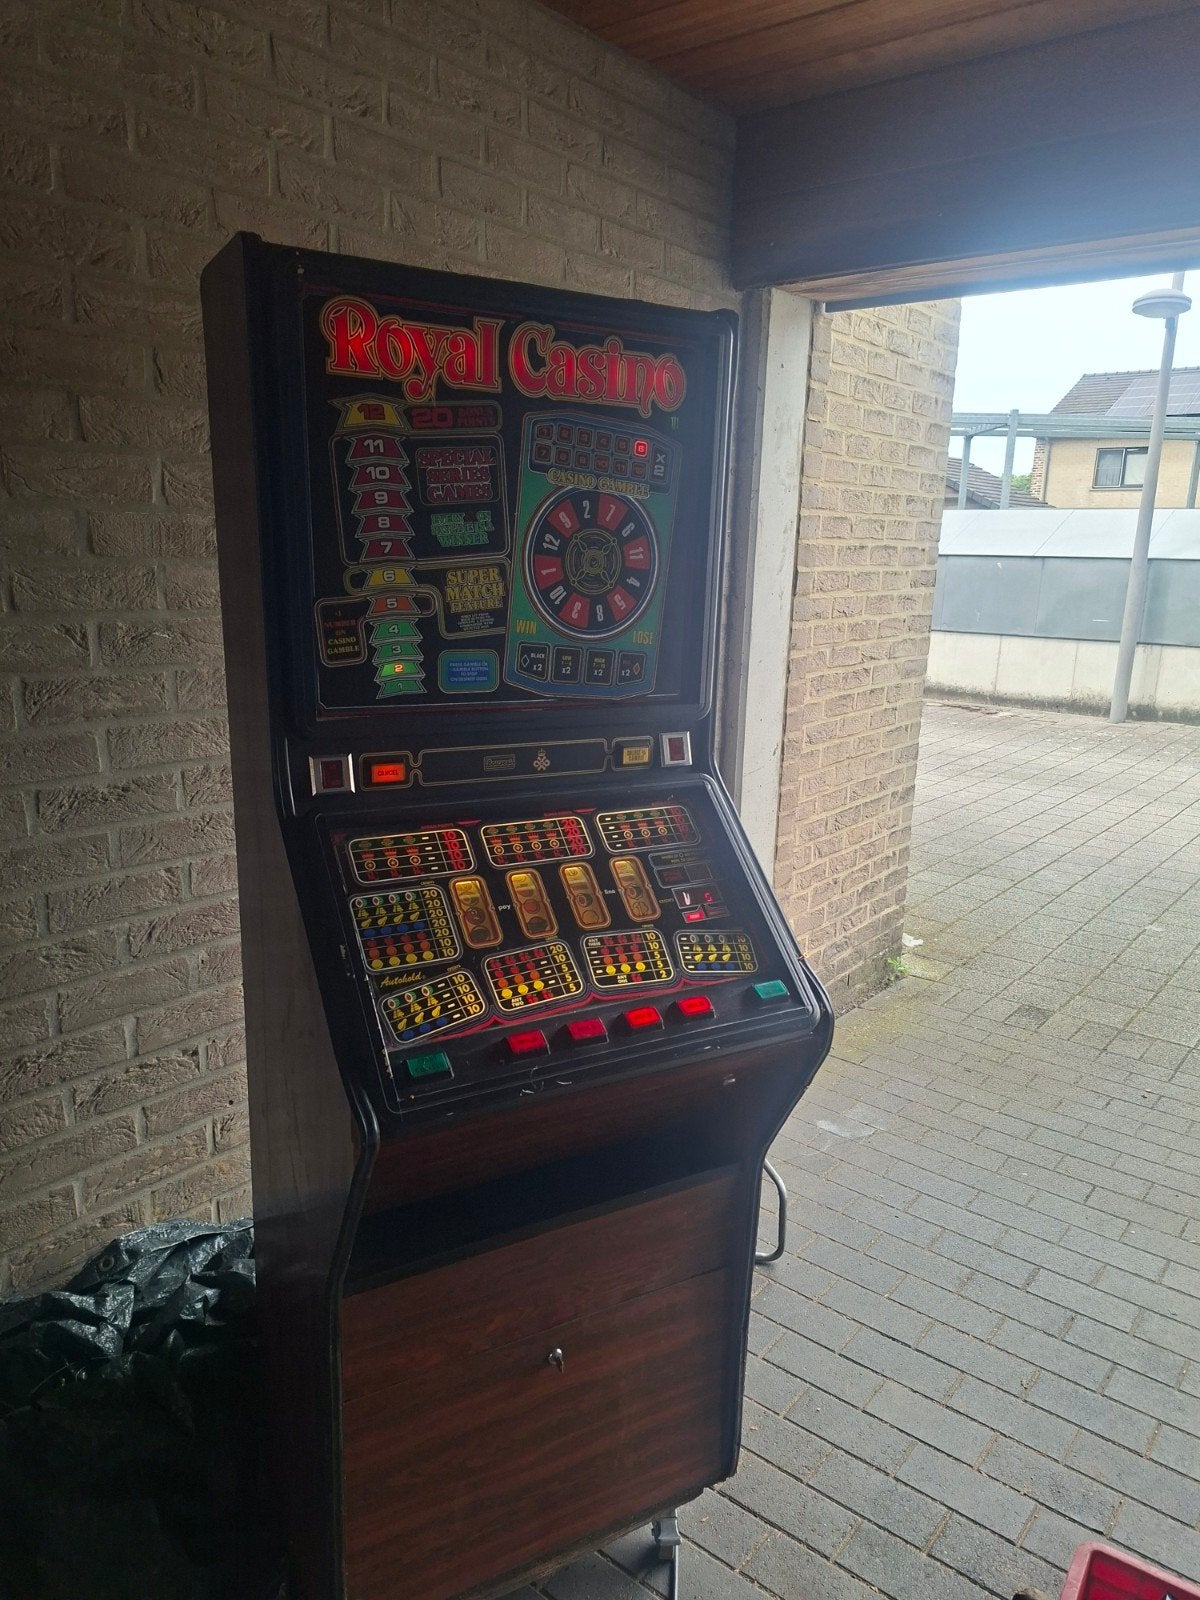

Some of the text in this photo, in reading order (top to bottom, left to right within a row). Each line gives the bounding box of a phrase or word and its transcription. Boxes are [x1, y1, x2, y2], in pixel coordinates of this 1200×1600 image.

[321, 295, 687, 418] Royal Casino
[357, 403, 386, 421] 12
[411, 406, 454, 430] 20
[364, 439, 385, 453] 11
[417, 449, 497, 468] SPECIAL
[366, 466, 390, 480] 10
[426, 466, 491, 485] SERIES
[654, 465, 665, 477] 2
[548, 468, 651, 499] CASINO GAMBLE
[374, 491, 388, 505] 9
[582, 500, 591, 519] 2
[377, 516, 390, 529] 8
[559, 511, 572, 529] 9
[542, 533, 561, 551] 12
[380, 541, 393, 554] 7
[629, 546, 644, 560] 11
[381, 570, 395, 582] 6
[446, 567, 500, 584] SUPER
[540, 567, 557, 576] 1
[626, 576, 641, 588] 4
[445, 582, 506, 602] MATCH
[550, 585, 567, 605] 10
[386, 598, 398, 609] 5
[614, 594, 627, 610] 5
[595, 604, 604, 622] 8
[388, 625, 400, 634] 4
[516, 619, 537, 635] WIN
[328, 636, 357, 645] CASINO
[327, 645, 360, 655] GAMBLE
[391, 645, 402, 654] 3
[394, 663, 404, 673] 2
[377, 769, 399, 777] CANCEL
[562, 819, 577, 828] 20
[443, 830, 457, 840] 10
[566, 828, 580, 837] 20
[446, 840, 460, 851] 10
[569, 837, 583, 846] 20
[449, 850, 463, 860] 10
[572, 846, 586, 855] 20
[452, 860, 466, 870] 10
[422, 889, 437, 898] 20
[425, 899, 441, 908] 20
[428, 908, 444, 917] 20
[431, 918, 447, 927] 20
[434, 928, 450, 937] 20
[645, 932, 656, 940] 10
[438, 938, 451, 947] 10
[649, 942, 659, 950] 10
[442, 948, 454, 957] 10
[550, 944, 563, 953] 20
[553, 953, 566, 962] 10
[653, 952, 661, 960] 5
[741, 953, 751, 961] 10
[561, 963, 569, 972] 5
[452, 974, 465, 984] 10
[565, 973, 572, 982] 5
[660, 970, 667, 978] 2
[380, 971, 423, 988] Autohold
[457, 984, 470, 994] 10
[569, 983, 576, 992] 5
[462, 994, 475, 1003] 10
[467, 1004, 480, 1014] 10
